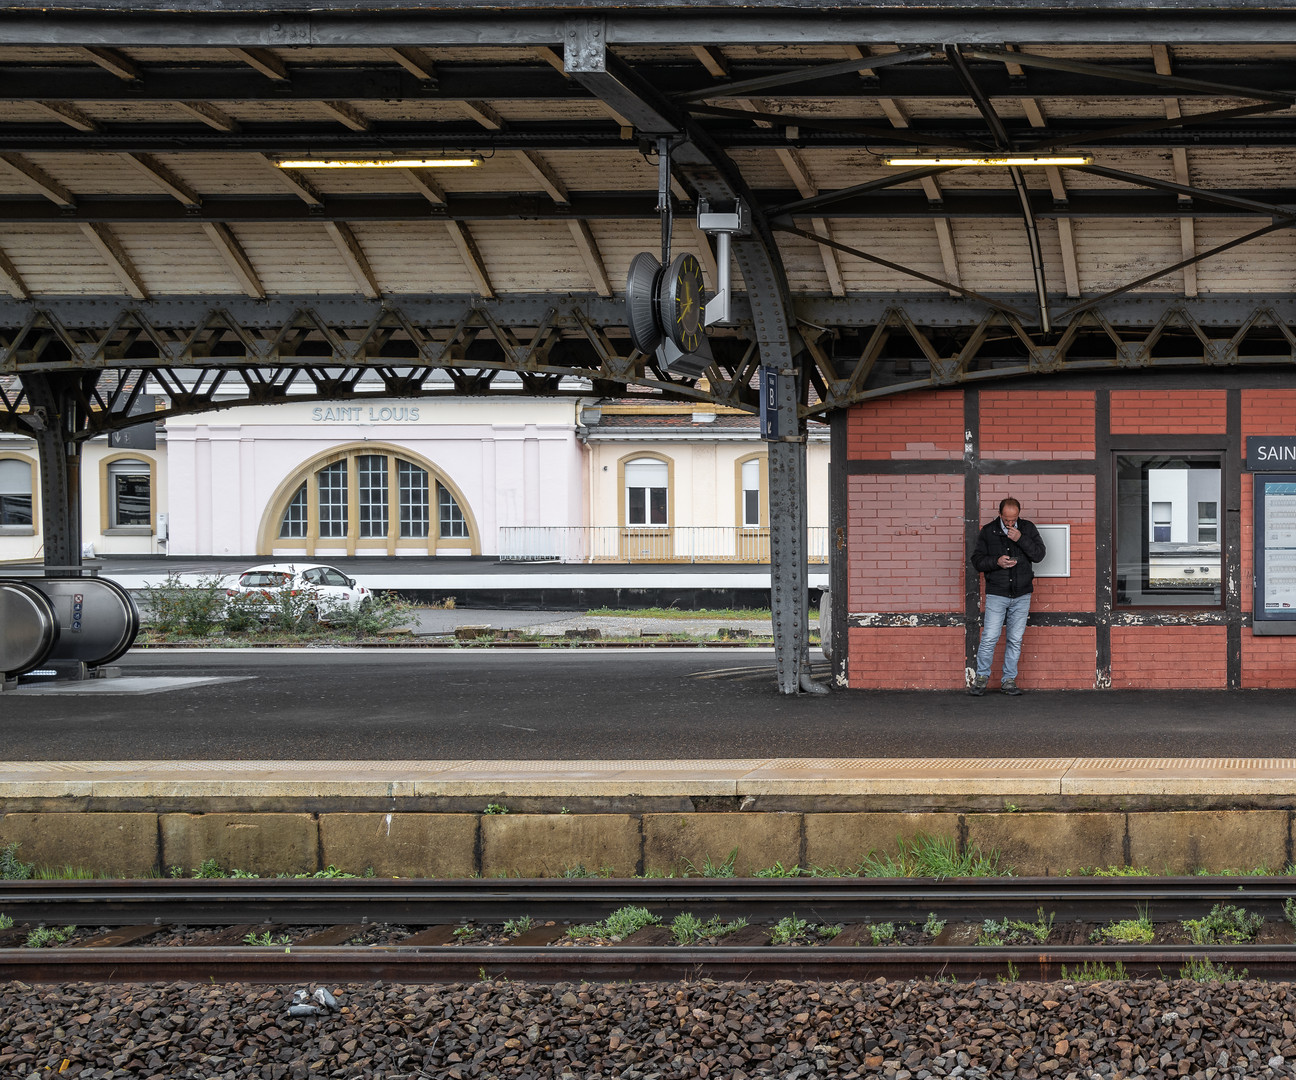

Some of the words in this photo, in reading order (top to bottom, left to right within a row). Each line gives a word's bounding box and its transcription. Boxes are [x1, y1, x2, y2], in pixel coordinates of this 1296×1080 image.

[770, 388, 774, 406] B
[312, 407, 363, 421] SAINT
[369, 407, 420, 421] LOUIS
